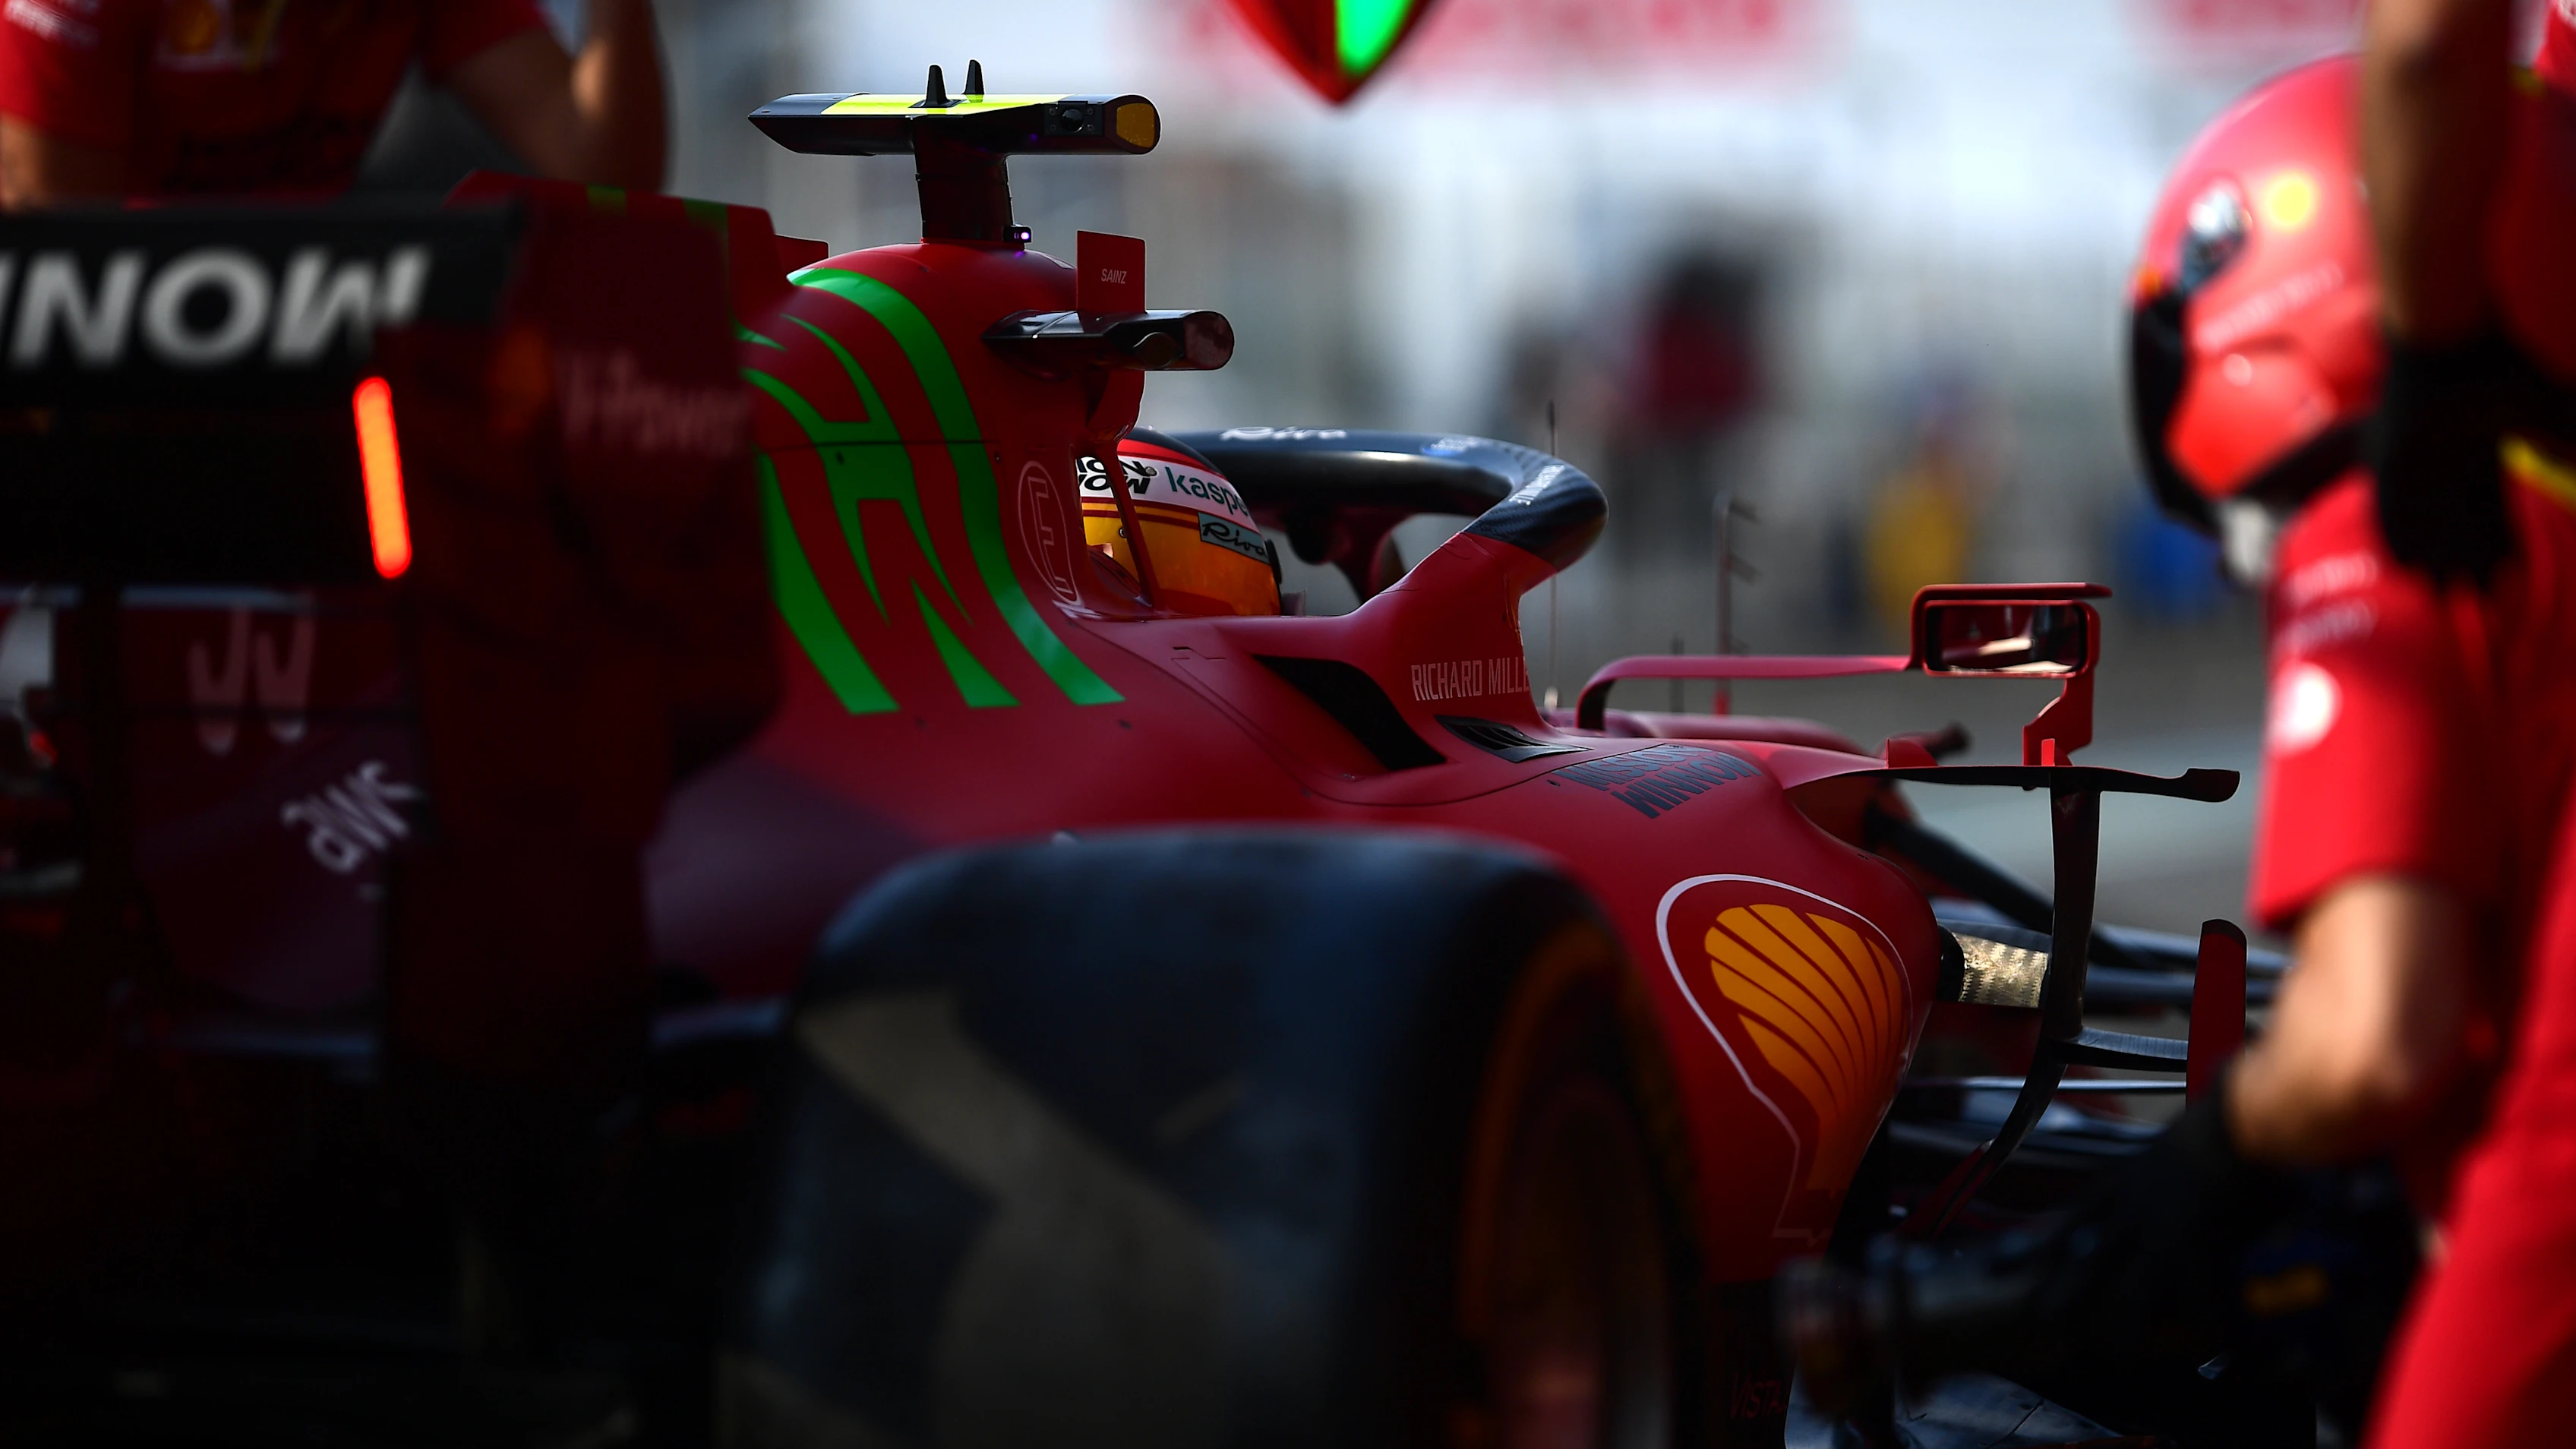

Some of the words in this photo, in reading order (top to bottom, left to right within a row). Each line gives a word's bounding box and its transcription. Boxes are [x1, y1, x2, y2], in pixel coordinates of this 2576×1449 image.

[1100, 267, 1128, 285] SAINZ
[0, 245, 433, 372] NOW
[1410, 659, 1483, 701] RICHARD
[1611, 751, 1763, 819] WINNOW
